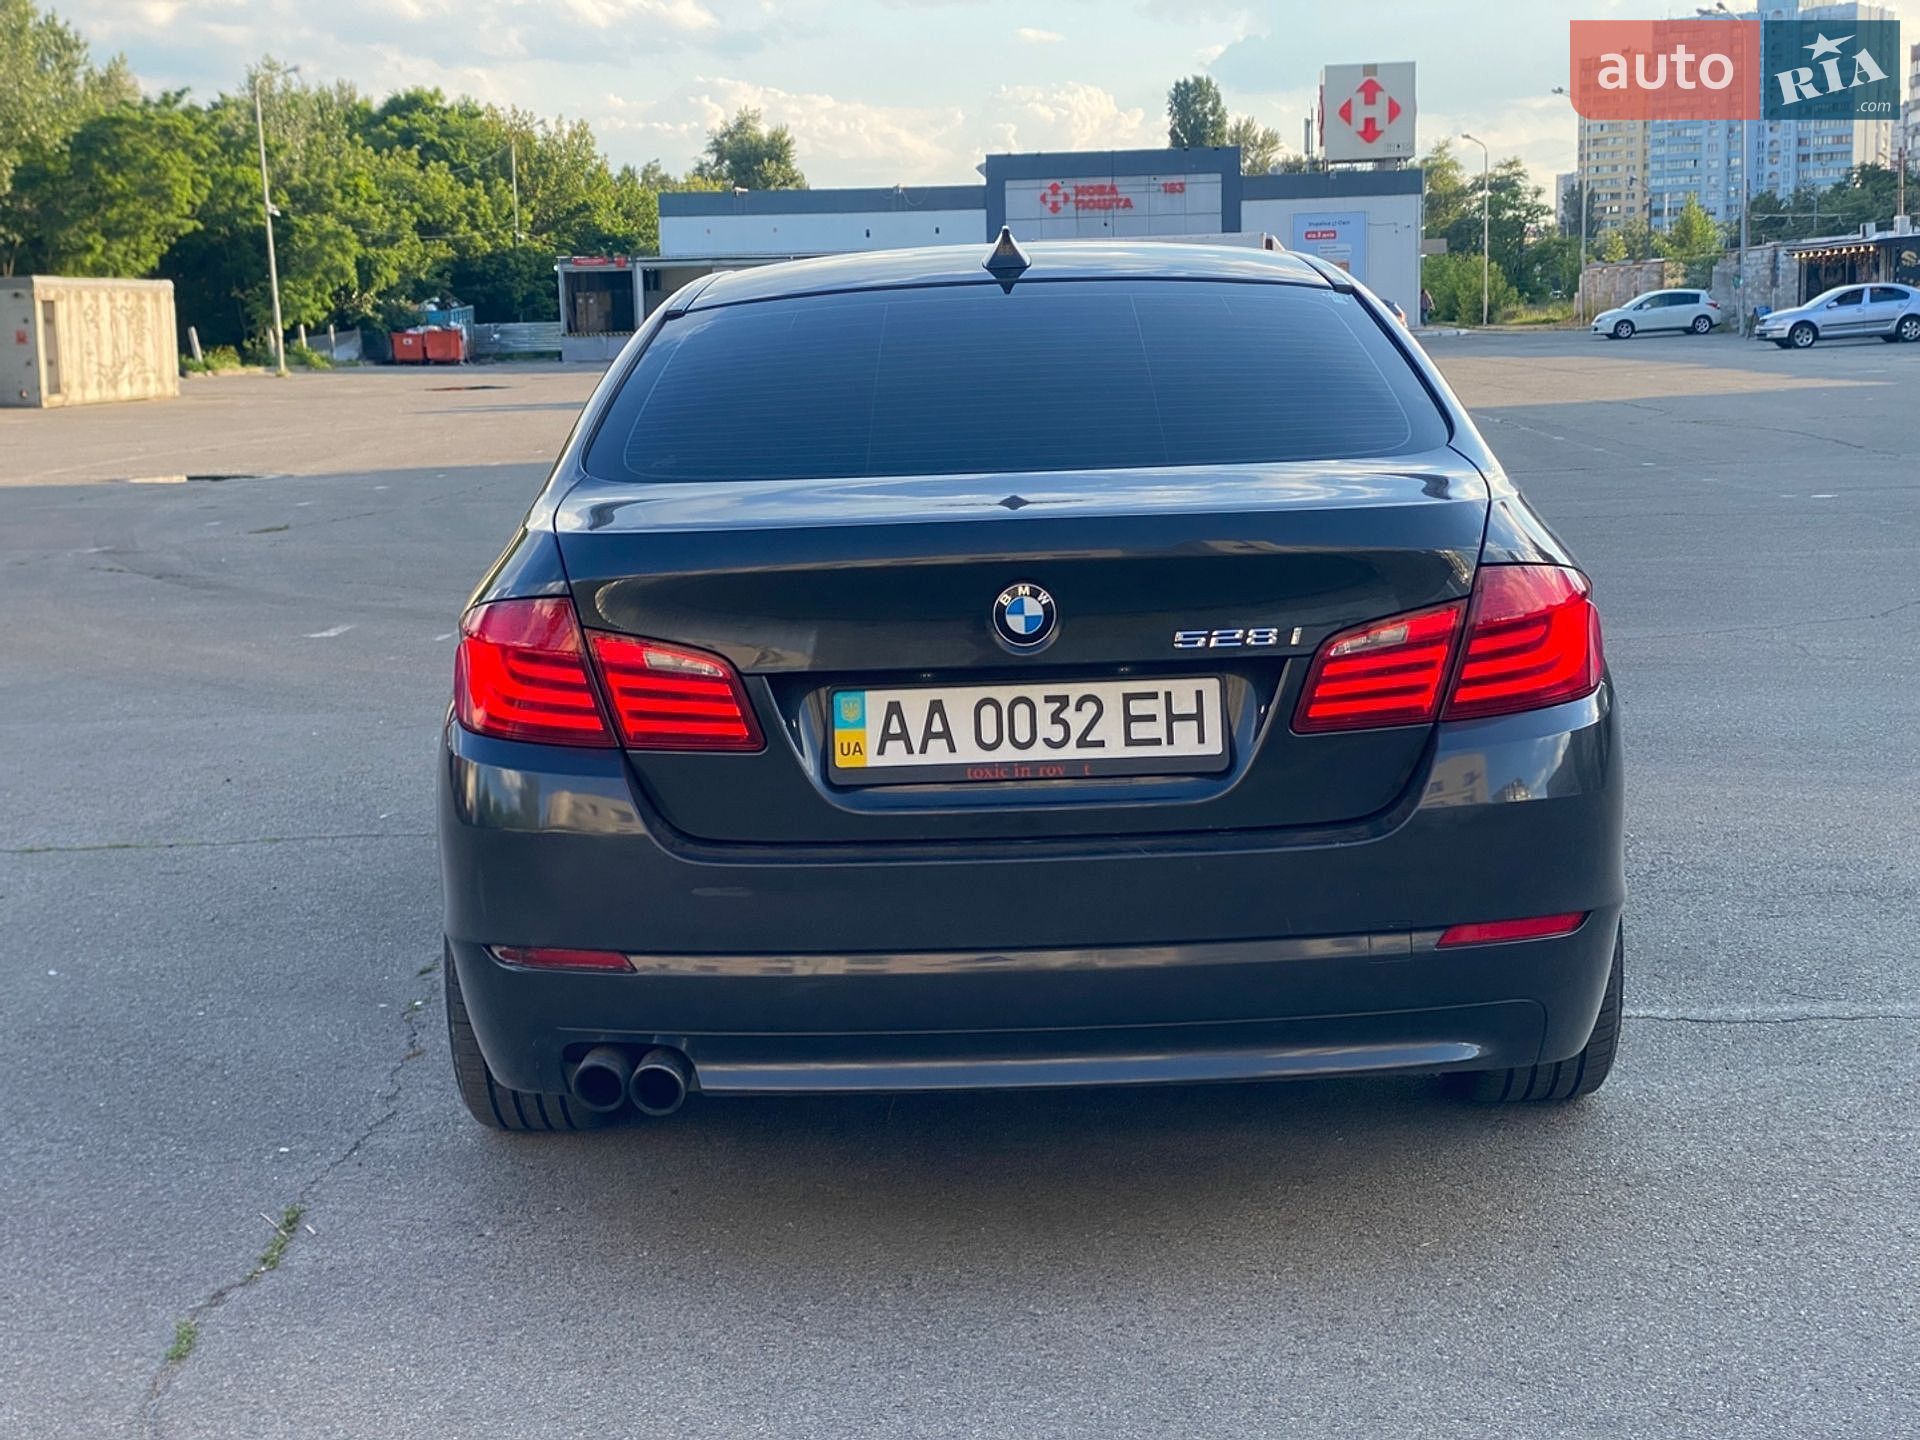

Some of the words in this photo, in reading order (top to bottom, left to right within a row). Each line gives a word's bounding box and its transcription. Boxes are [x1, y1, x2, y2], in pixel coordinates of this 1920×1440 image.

[1000, 586, 1050, 606] BMW
[876, 699, 957, 756] AA
[973, 694, 1106, 752] 0032
[1122, 689, 1206, 747] EH
[840, 741, 864, 757] UA
[966, 764, 1008, 779] toxic
[1013, 763, 1031, 777] in
